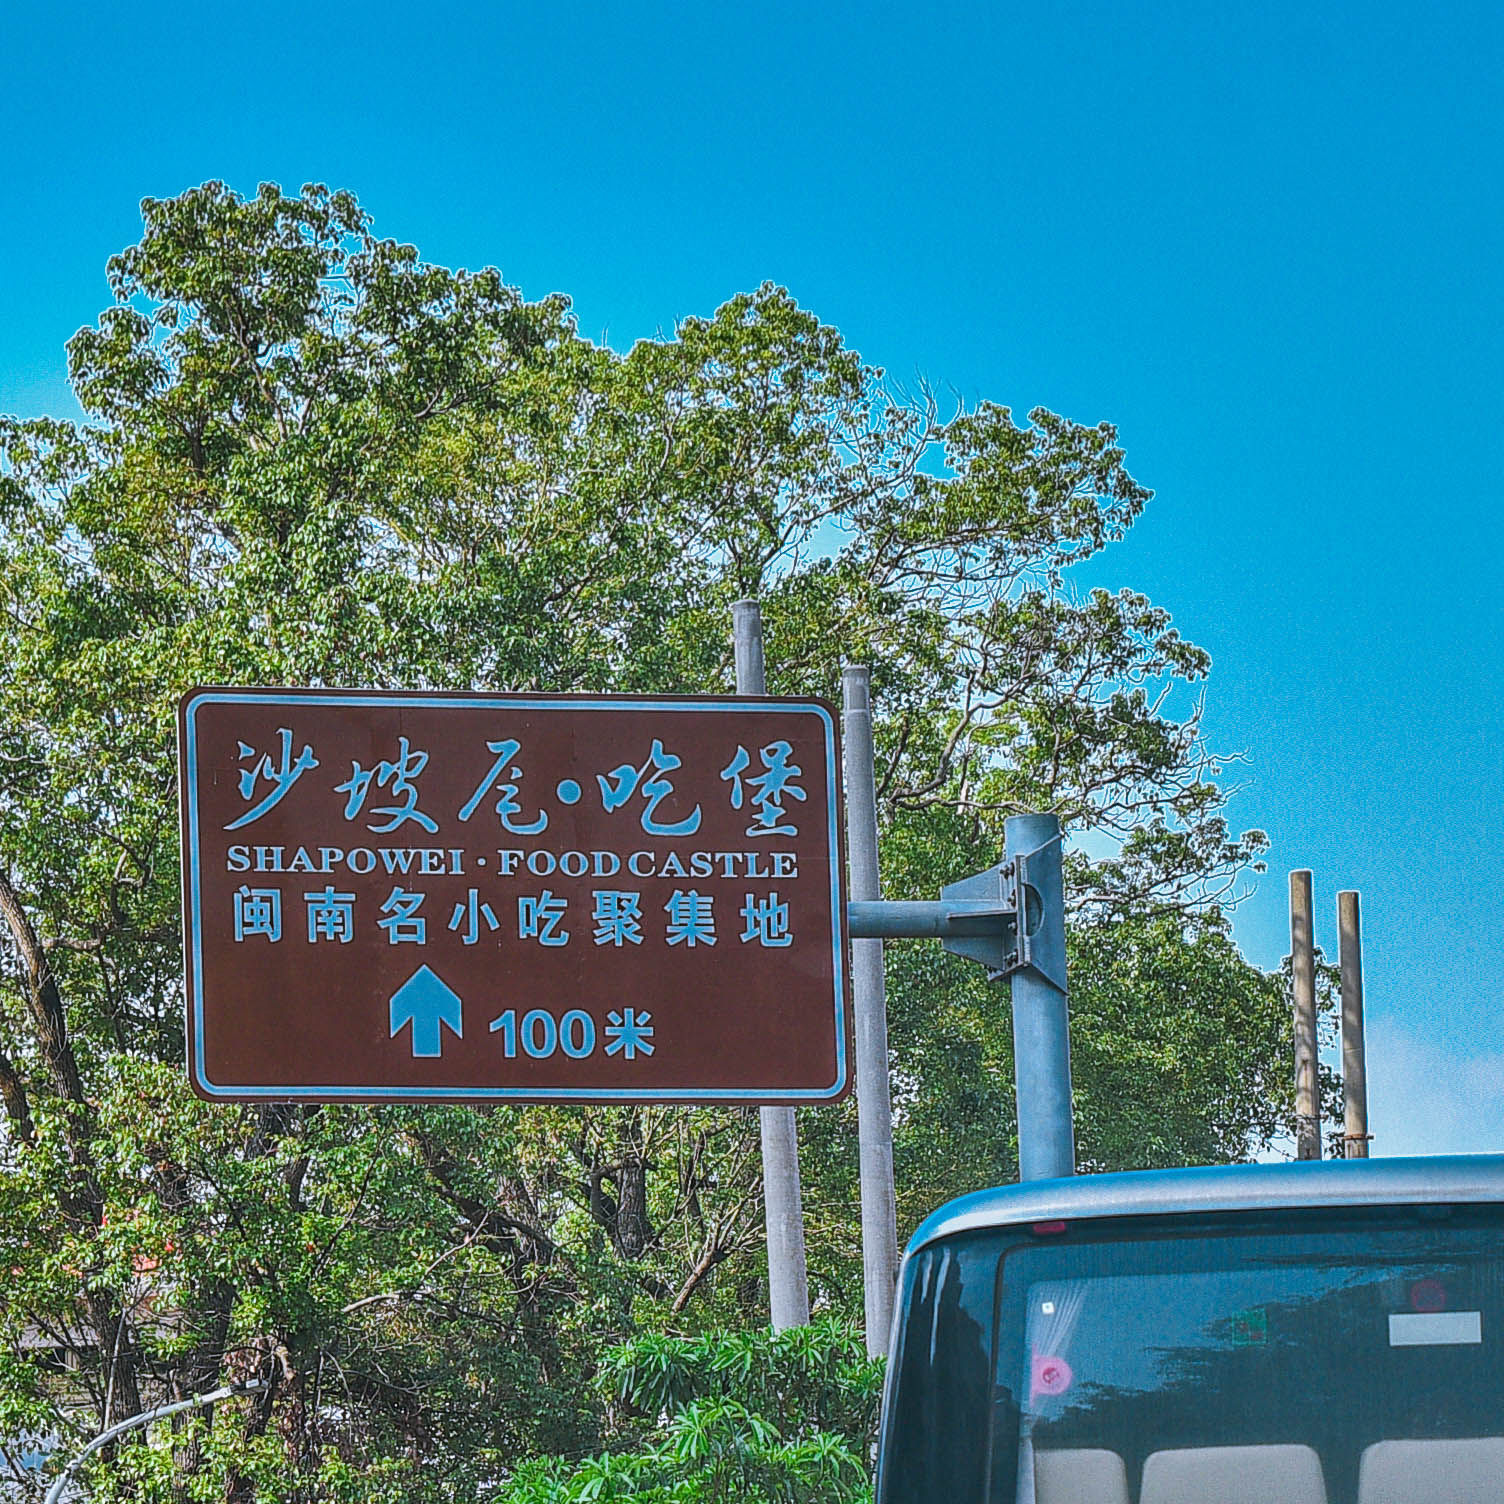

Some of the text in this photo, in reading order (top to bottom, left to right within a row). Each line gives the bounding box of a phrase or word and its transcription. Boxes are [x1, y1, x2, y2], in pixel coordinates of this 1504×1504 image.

[224, 728, 808, 838] 沙坡尾·吃堡
[226, 845, 466, 875] SHAPOWEI
[233, 884, 795, 948] 闽南名小吃聚集地
[488, 1007, 655, 1061] 100米
